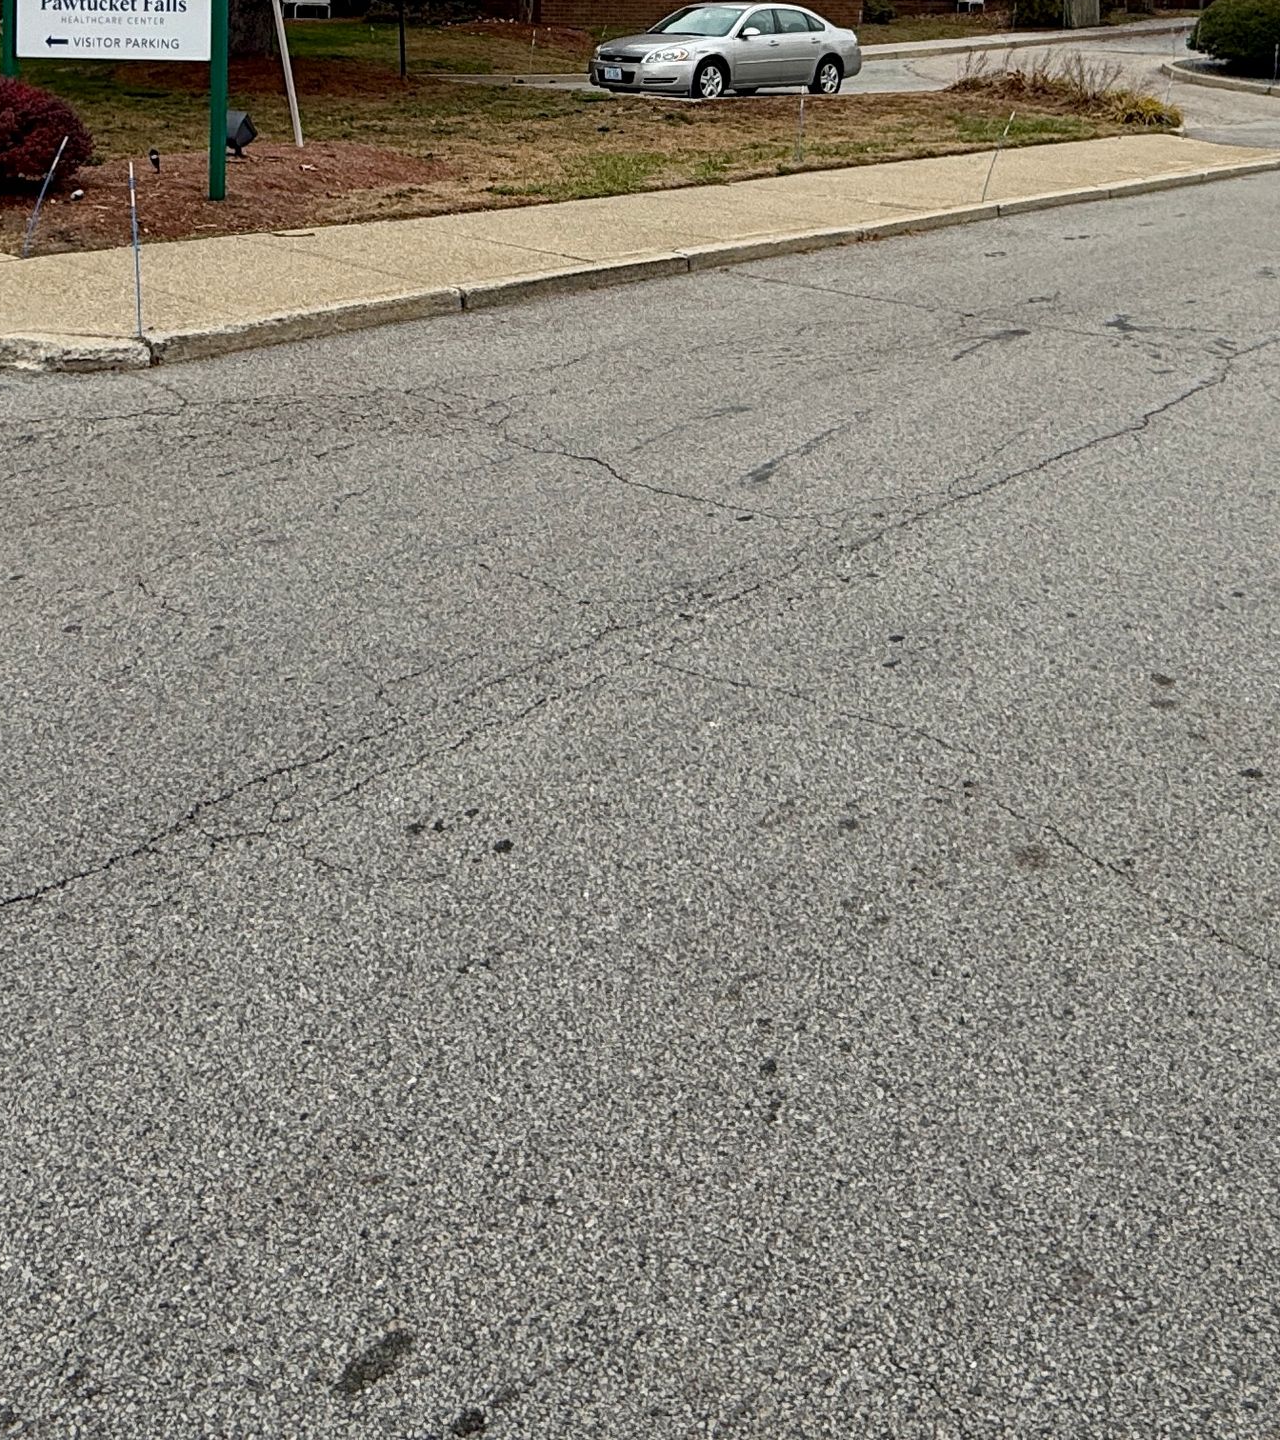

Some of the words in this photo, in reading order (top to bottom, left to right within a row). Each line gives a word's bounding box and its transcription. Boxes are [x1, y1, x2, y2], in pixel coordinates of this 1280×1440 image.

[61, 15, 122, 25] HEALTHCARE
[127, 16, 165, 26] CENTER
[73, 37, 121, 48] VISITOR
[125, 38, 180, 50] PARKING
